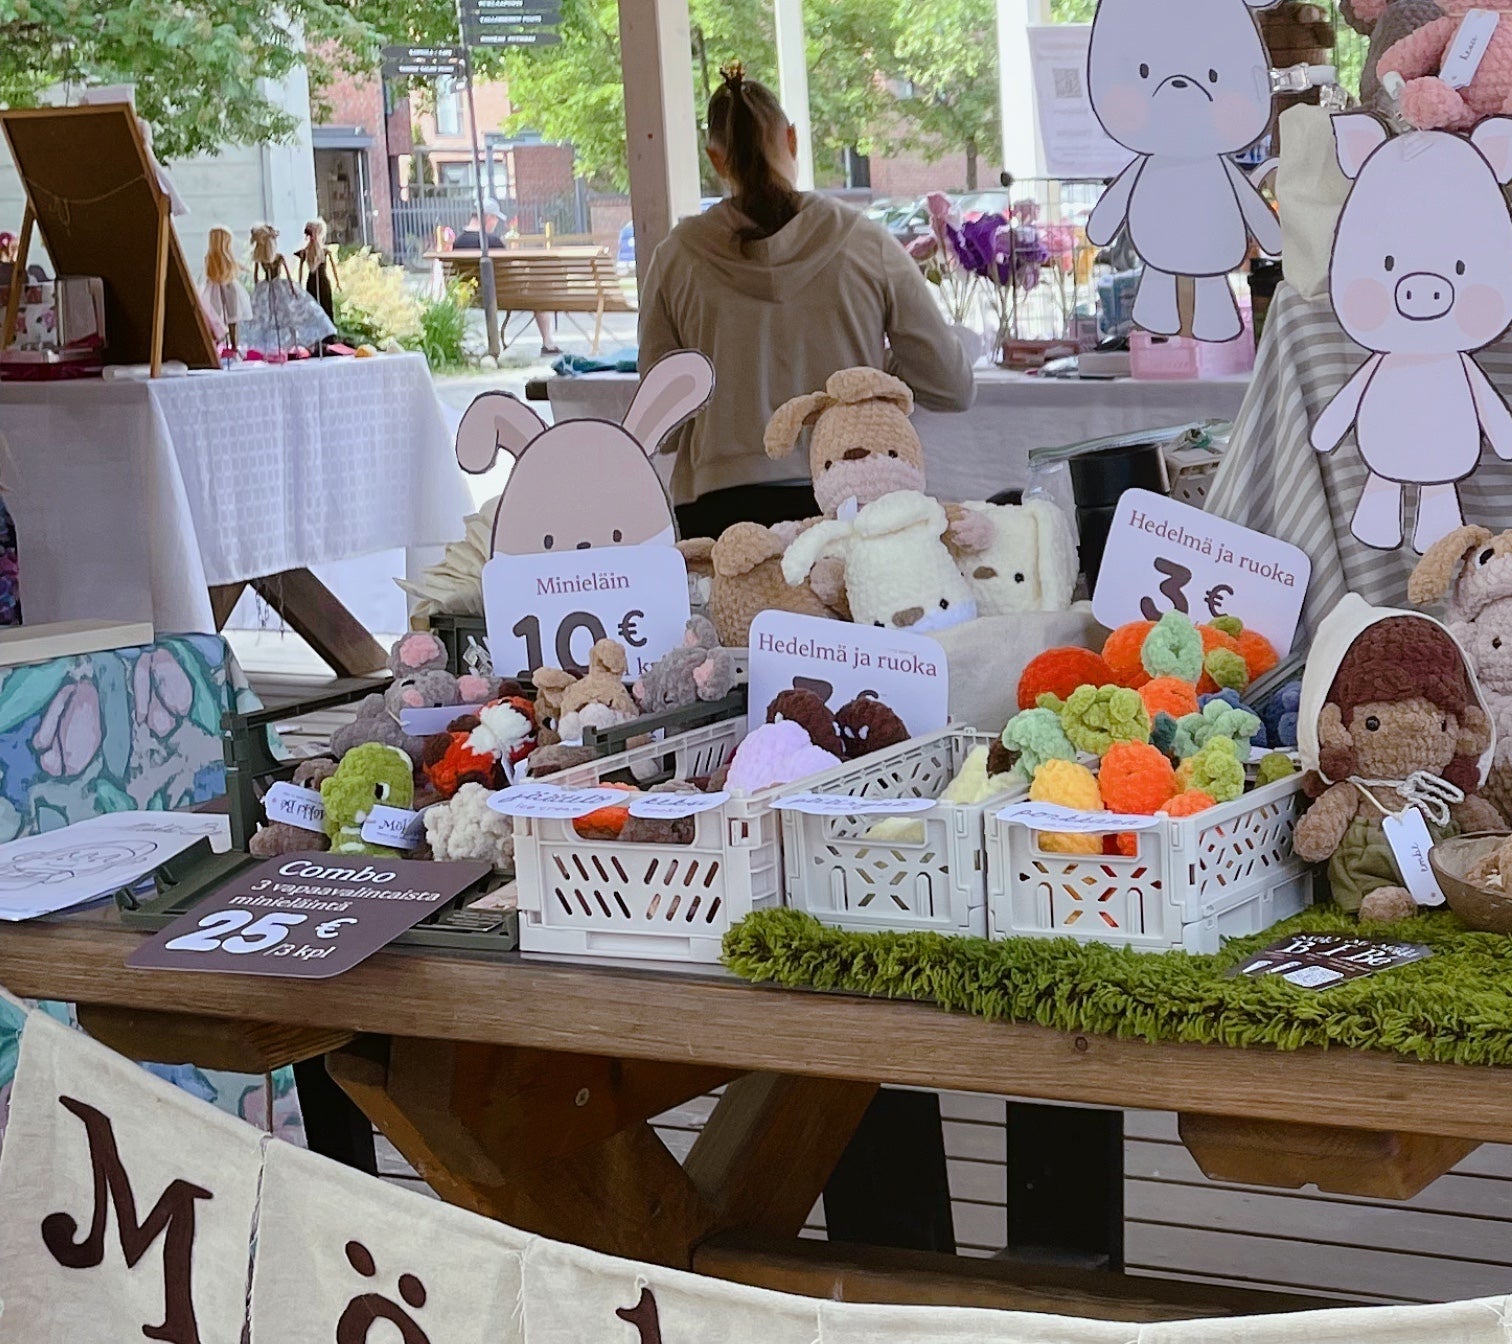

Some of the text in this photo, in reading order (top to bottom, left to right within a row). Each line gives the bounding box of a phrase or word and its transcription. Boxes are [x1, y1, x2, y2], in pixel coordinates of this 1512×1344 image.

[1128, 509, 1296, 587] Hedelmä ja ruoka
[536, 572, 630, 596] Minieläin
[1140, 556, 1192, 622] 3
[512, 610, 608, 680] 10
[758, 632, 937, 677] Hedelmä ja ruoka
[278, 860, 397, 884] Combo
[228, 893, 354, 913] minieläintä
[251, 879, 440, 902] 3 vapaavalintaista
[165, 909, 358, 954] 25 €
[293, 945, 336, 961] kpl
